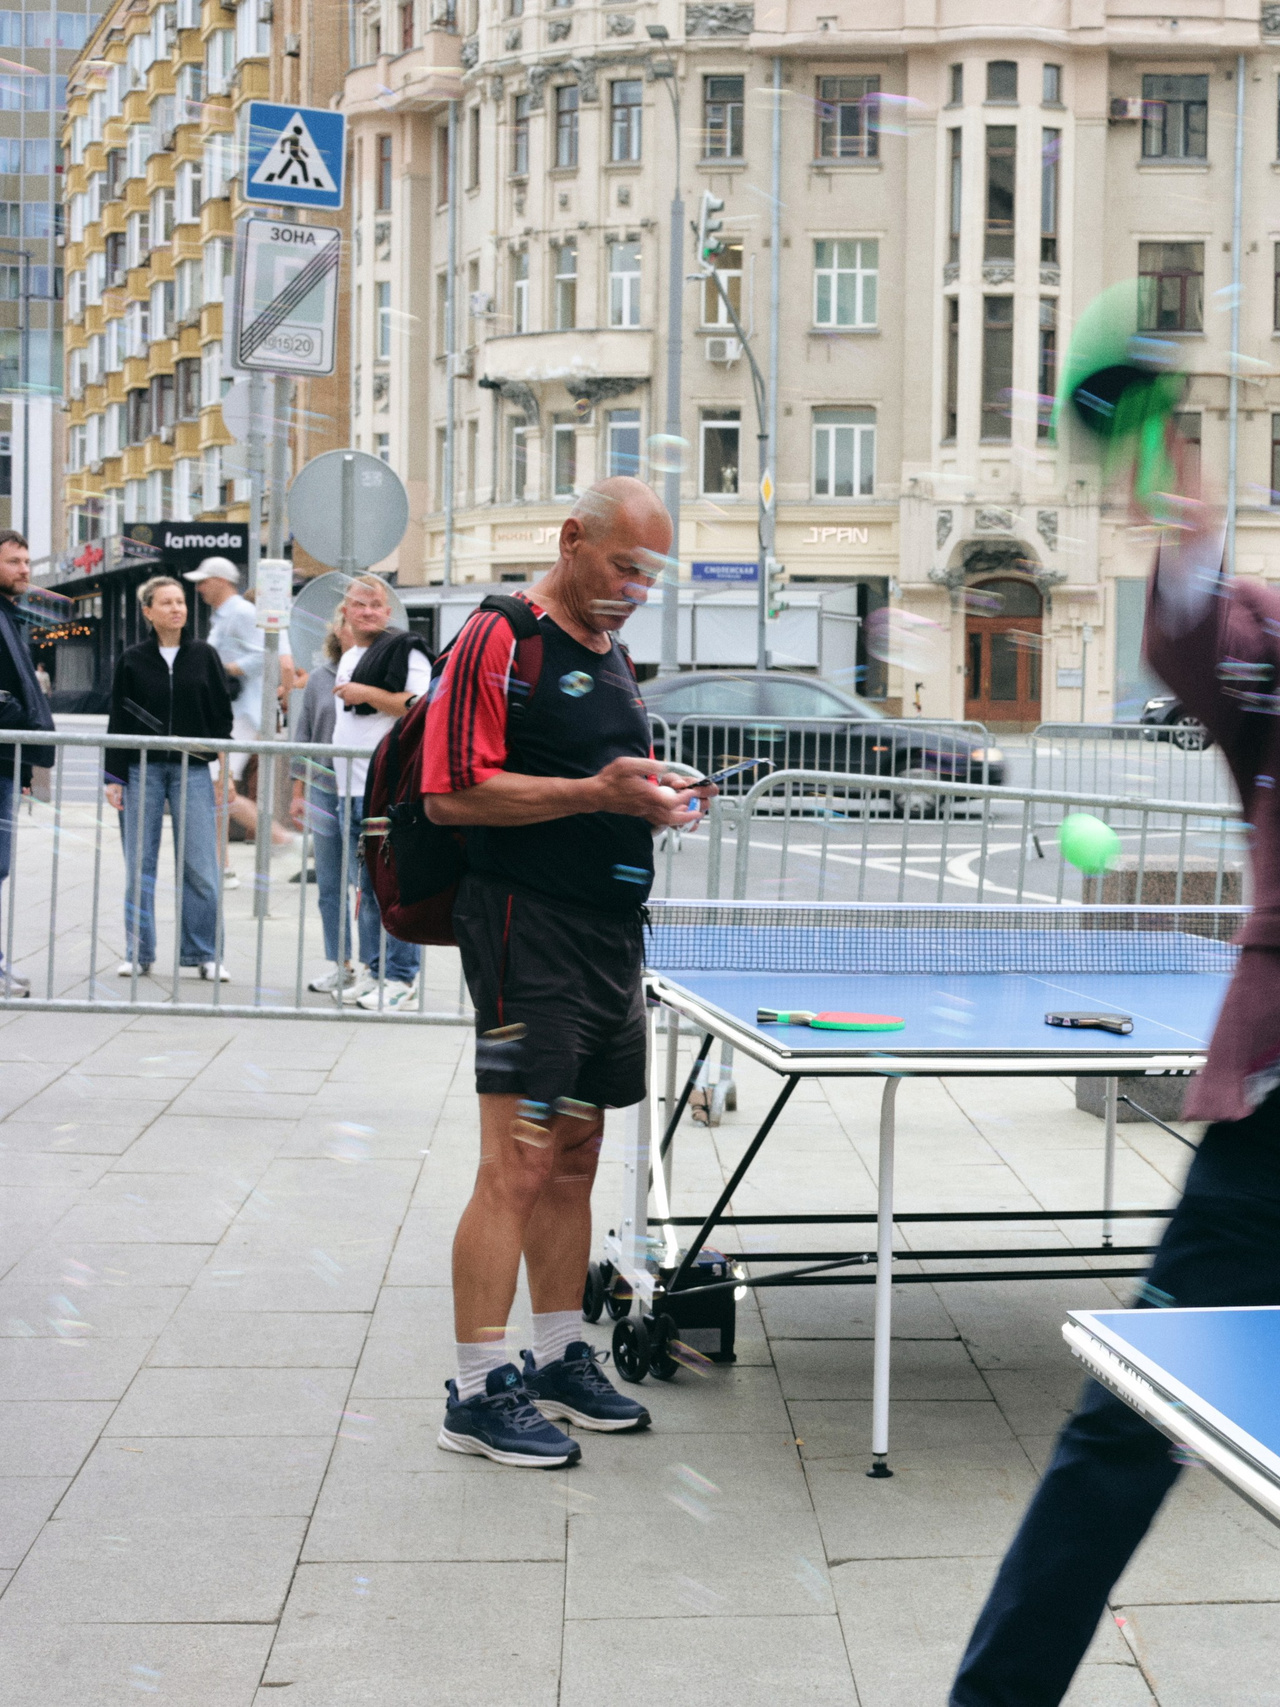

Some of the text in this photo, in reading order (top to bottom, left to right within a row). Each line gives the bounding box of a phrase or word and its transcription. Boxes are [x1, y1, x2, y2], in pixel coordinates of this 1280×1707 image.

[270, 227, 316, 245] ЗОНА
[278, 338, 290, 349] 15
[294, 339, 310, 351] 20
[165, 532, 242, 549] lamoda
